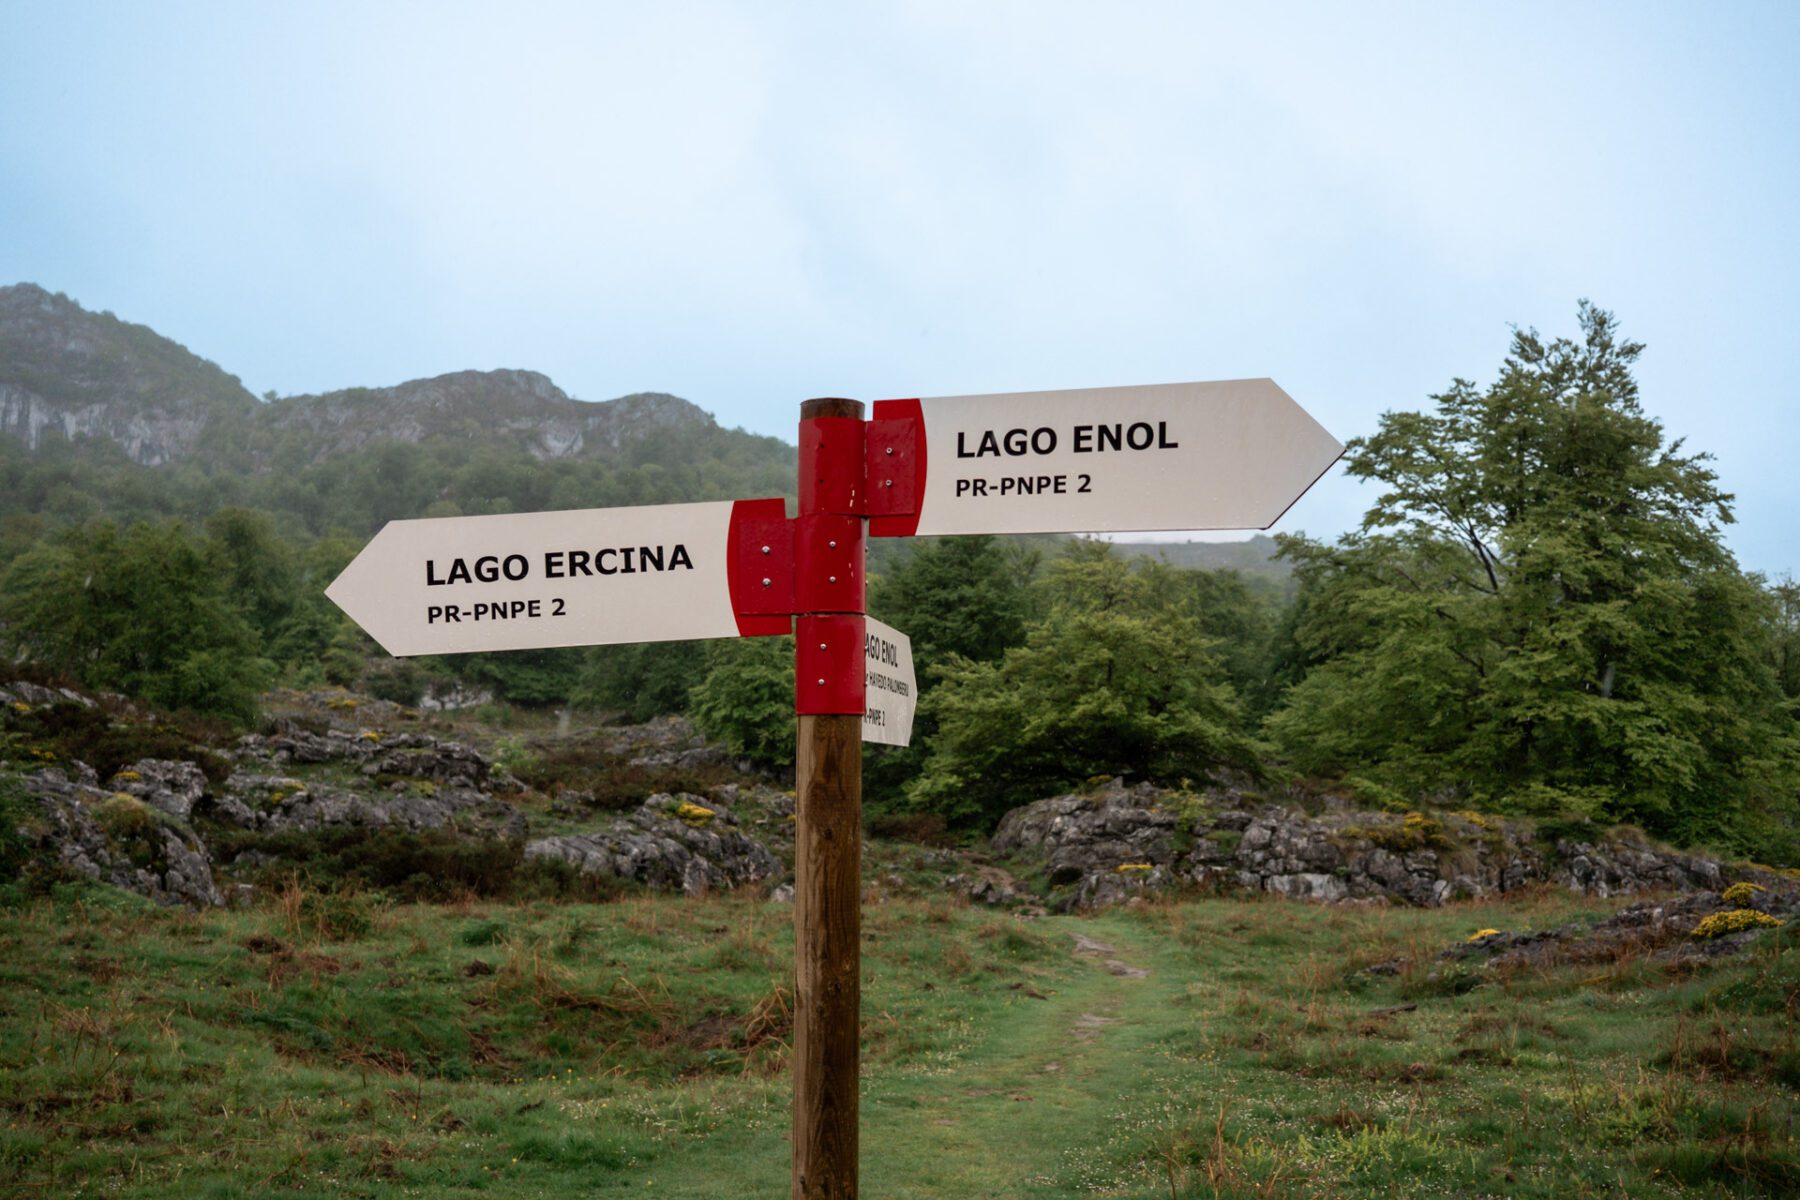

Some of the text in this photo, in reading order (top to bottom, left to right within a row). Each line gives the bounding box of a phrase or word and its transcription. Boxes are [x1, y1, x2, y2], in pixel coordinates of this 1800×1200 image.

[957, 420, 1179, 458] LAGO ENOL
[956, 473, 1092, 497] PR-PNPE 2
[426, 543, 694, 585] LAGO ERCINA
[427, 597, 567, 625] PR-PNPE 2
[865, 632, 898, 668] AGO ENOL
[864, 707, 886, 727] -PNPE 2
